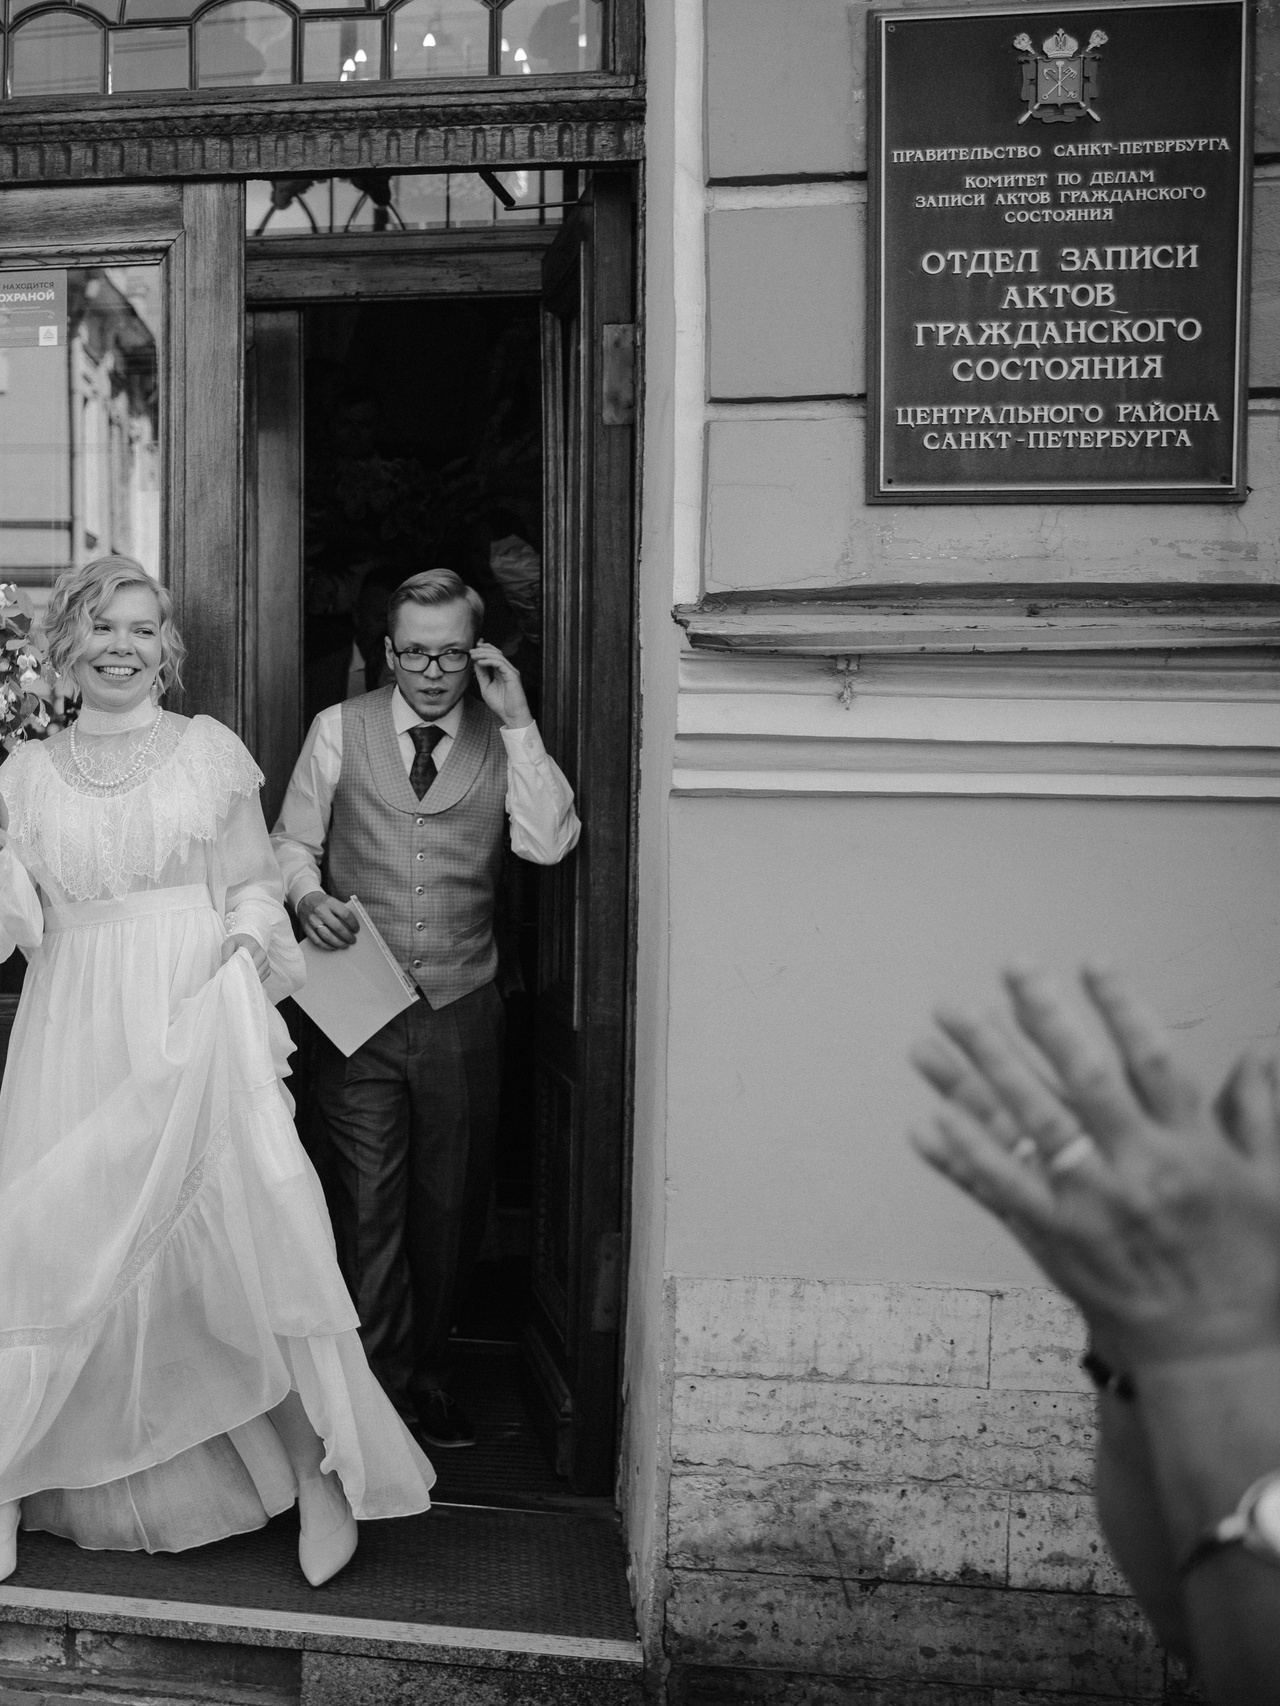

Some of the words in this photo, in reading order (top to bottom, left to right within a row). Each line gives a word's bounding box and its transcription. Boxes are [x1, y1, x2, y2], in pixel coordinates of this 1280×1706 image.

[891, 145, 1042, 163] ПРАВИТЕЛЬСТВО
[1053, 138, 1230, 157] САНКТ-ПЕТЕРБУРГА
[965, 173, 1048, 189] КОМИТЕТ
[1057, 172, 1082, 186] ПО
[1089, 170, 1154, 187] ДЕЛАМ
[915, 193, 986, 208] ЗАПИСИ
[995, 191, 1051, 205] АКТОВ
[1059, 186, 1206, 204] ГРАЖДАНСКОГО
[1004, 208, 1113, 223] СОСТОЯНИЯ
[921, 249, 1039, 278] ОТДЕЛ
[1060, 244, 1199, 272] ЗАПИСИ
[3, 281, 55, 291] НАХОДИТСЯ
[1001, 283, 1116, 309] АКТОВ
[914, 318, 1202, 350] ГРАЖДАНСКОГО
[952, 355, 1163, 382] СОСТОЯНИЯ
[895, 404, 1104, 428] ЦЕНТРАЛЬНОГО
[1115, 400, 1220, 423] РАЙОНА
[923, 429, 1192, 450] САНКТ-ПЕТЕРБУРГА
